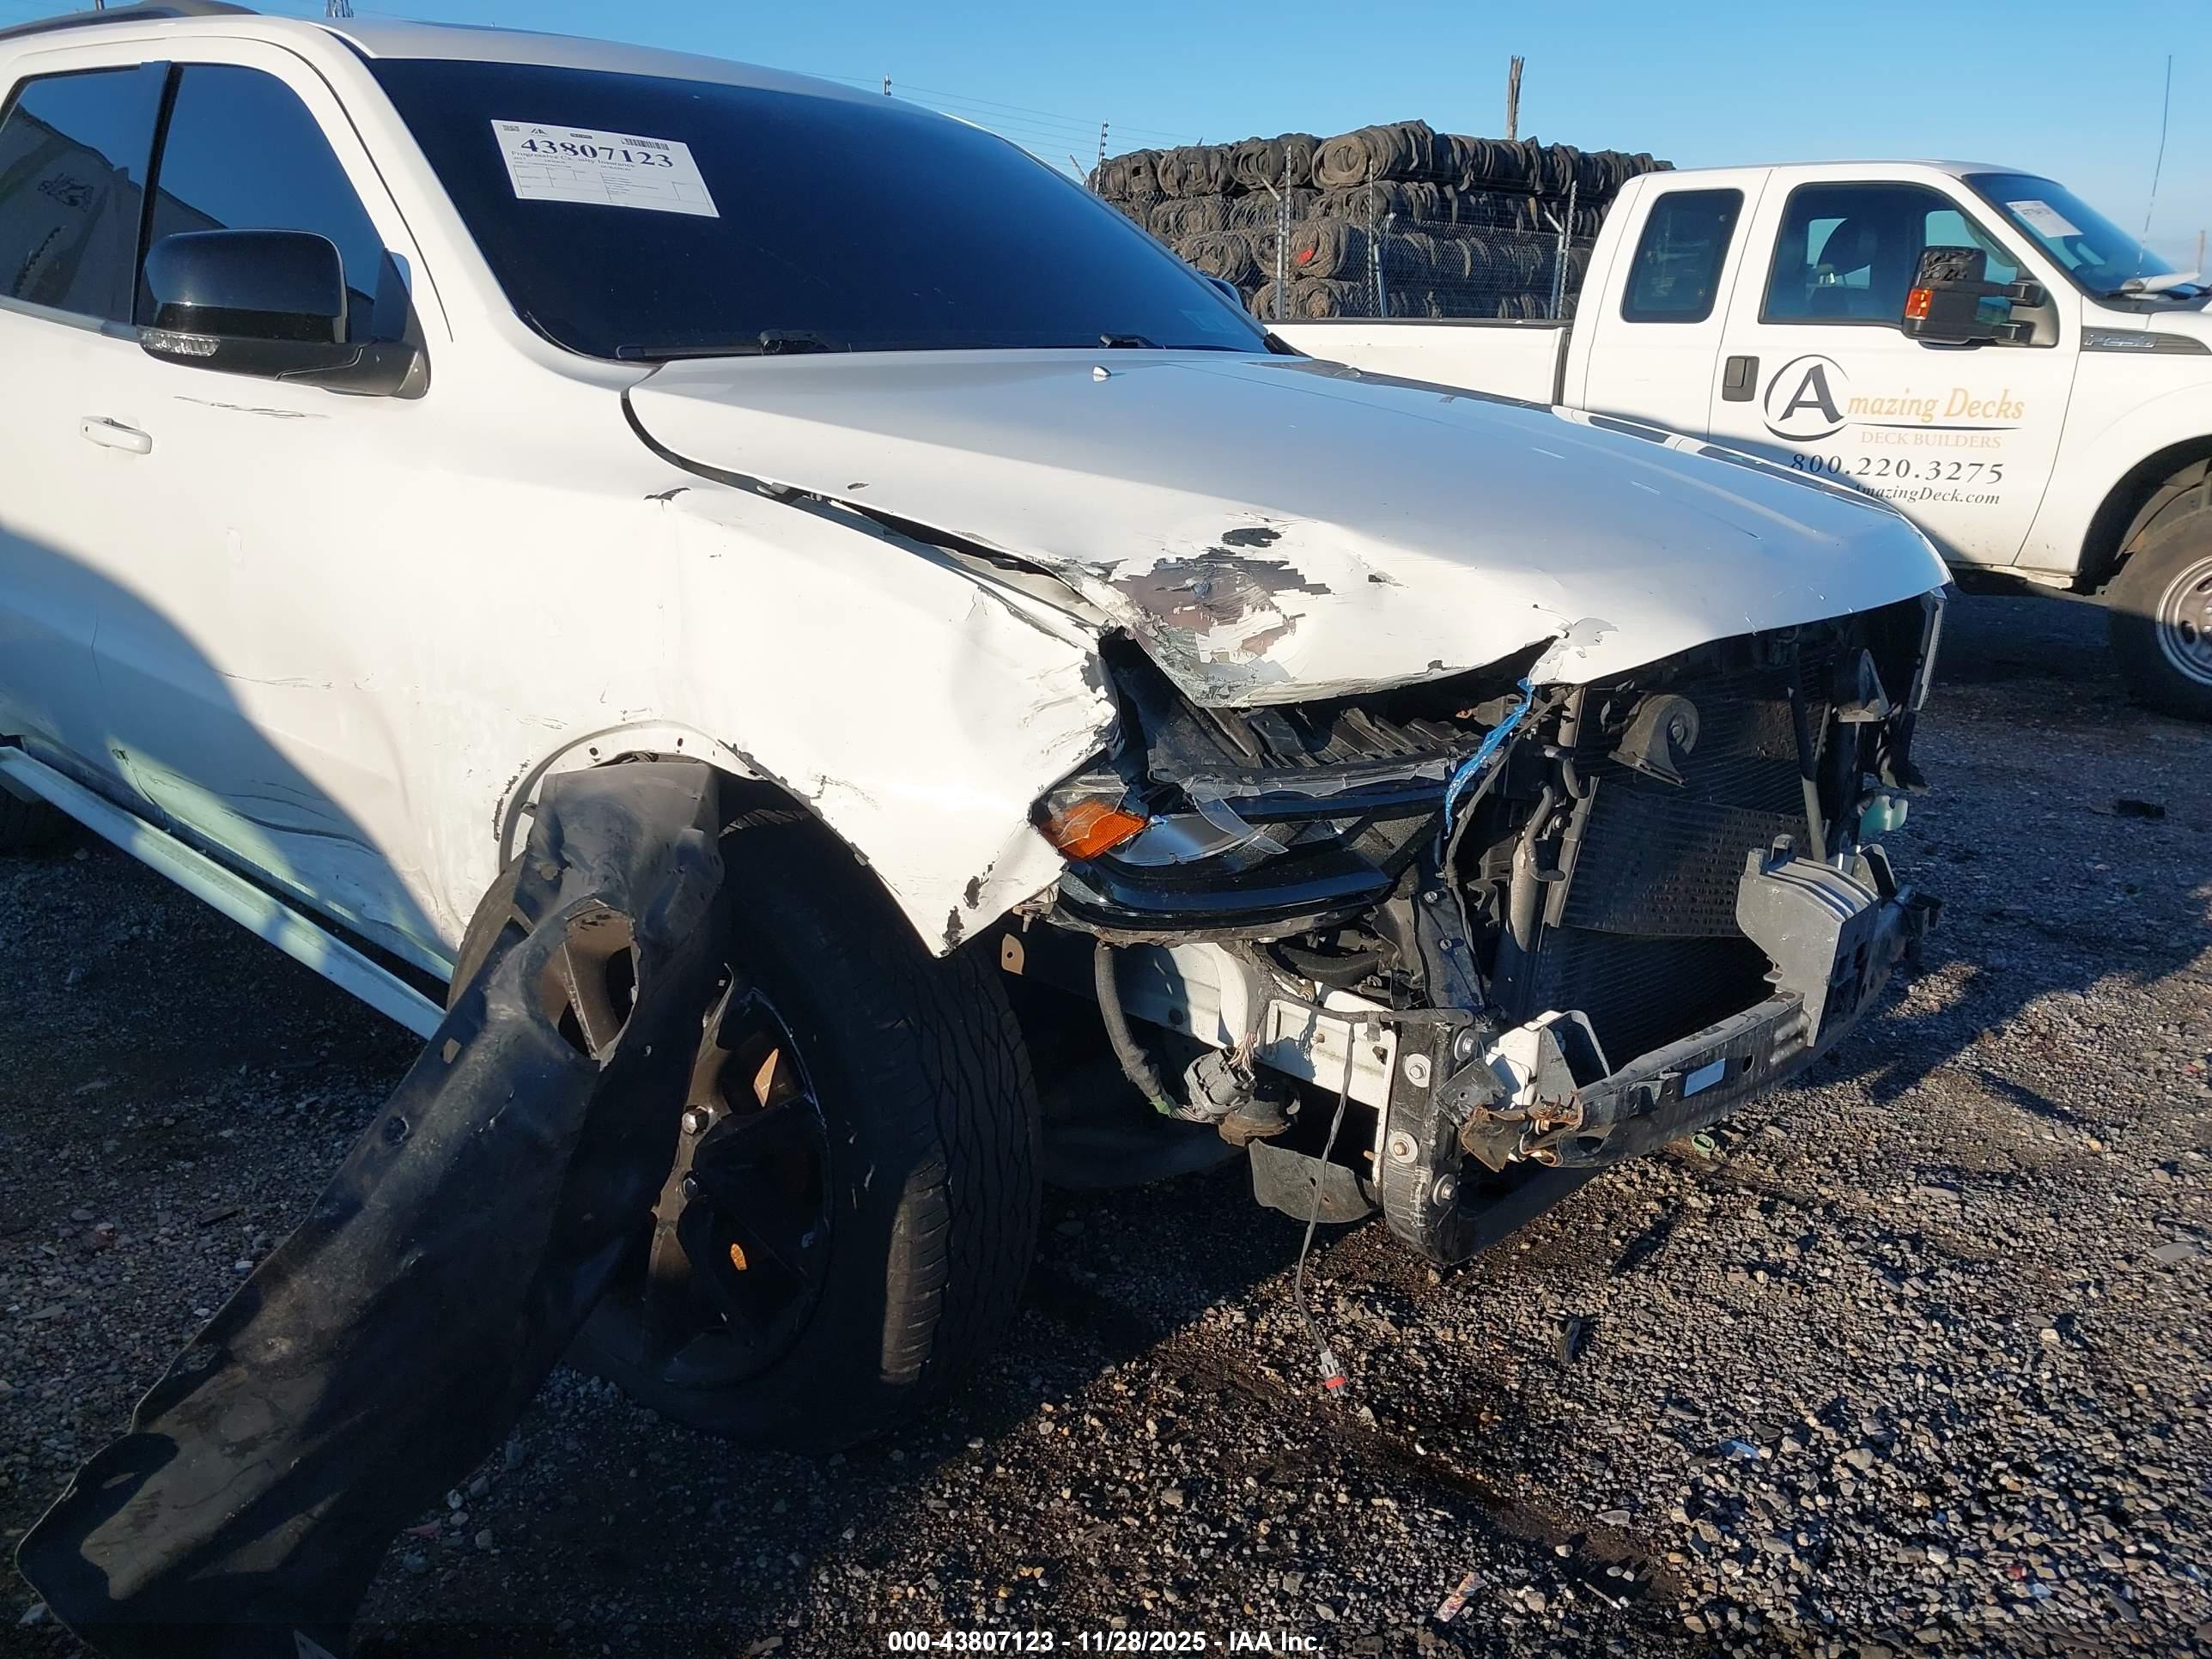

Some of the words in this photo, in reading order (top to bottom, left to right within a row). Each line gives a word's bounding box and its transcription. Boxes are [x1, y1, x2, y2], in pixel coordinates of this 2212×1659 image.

[511, 150, 559, 160] Progressive
[598, 159, 635, 168] Insurance
[520, 138, 674, 169] 43807123
[1943, 388, 2025, 420] Decks
[1861, 431, 1908, 446] DECK
[1915, 433, 2002, 448] BUILDERS
[1791, 453, 2003, 484] 800.220.3275
